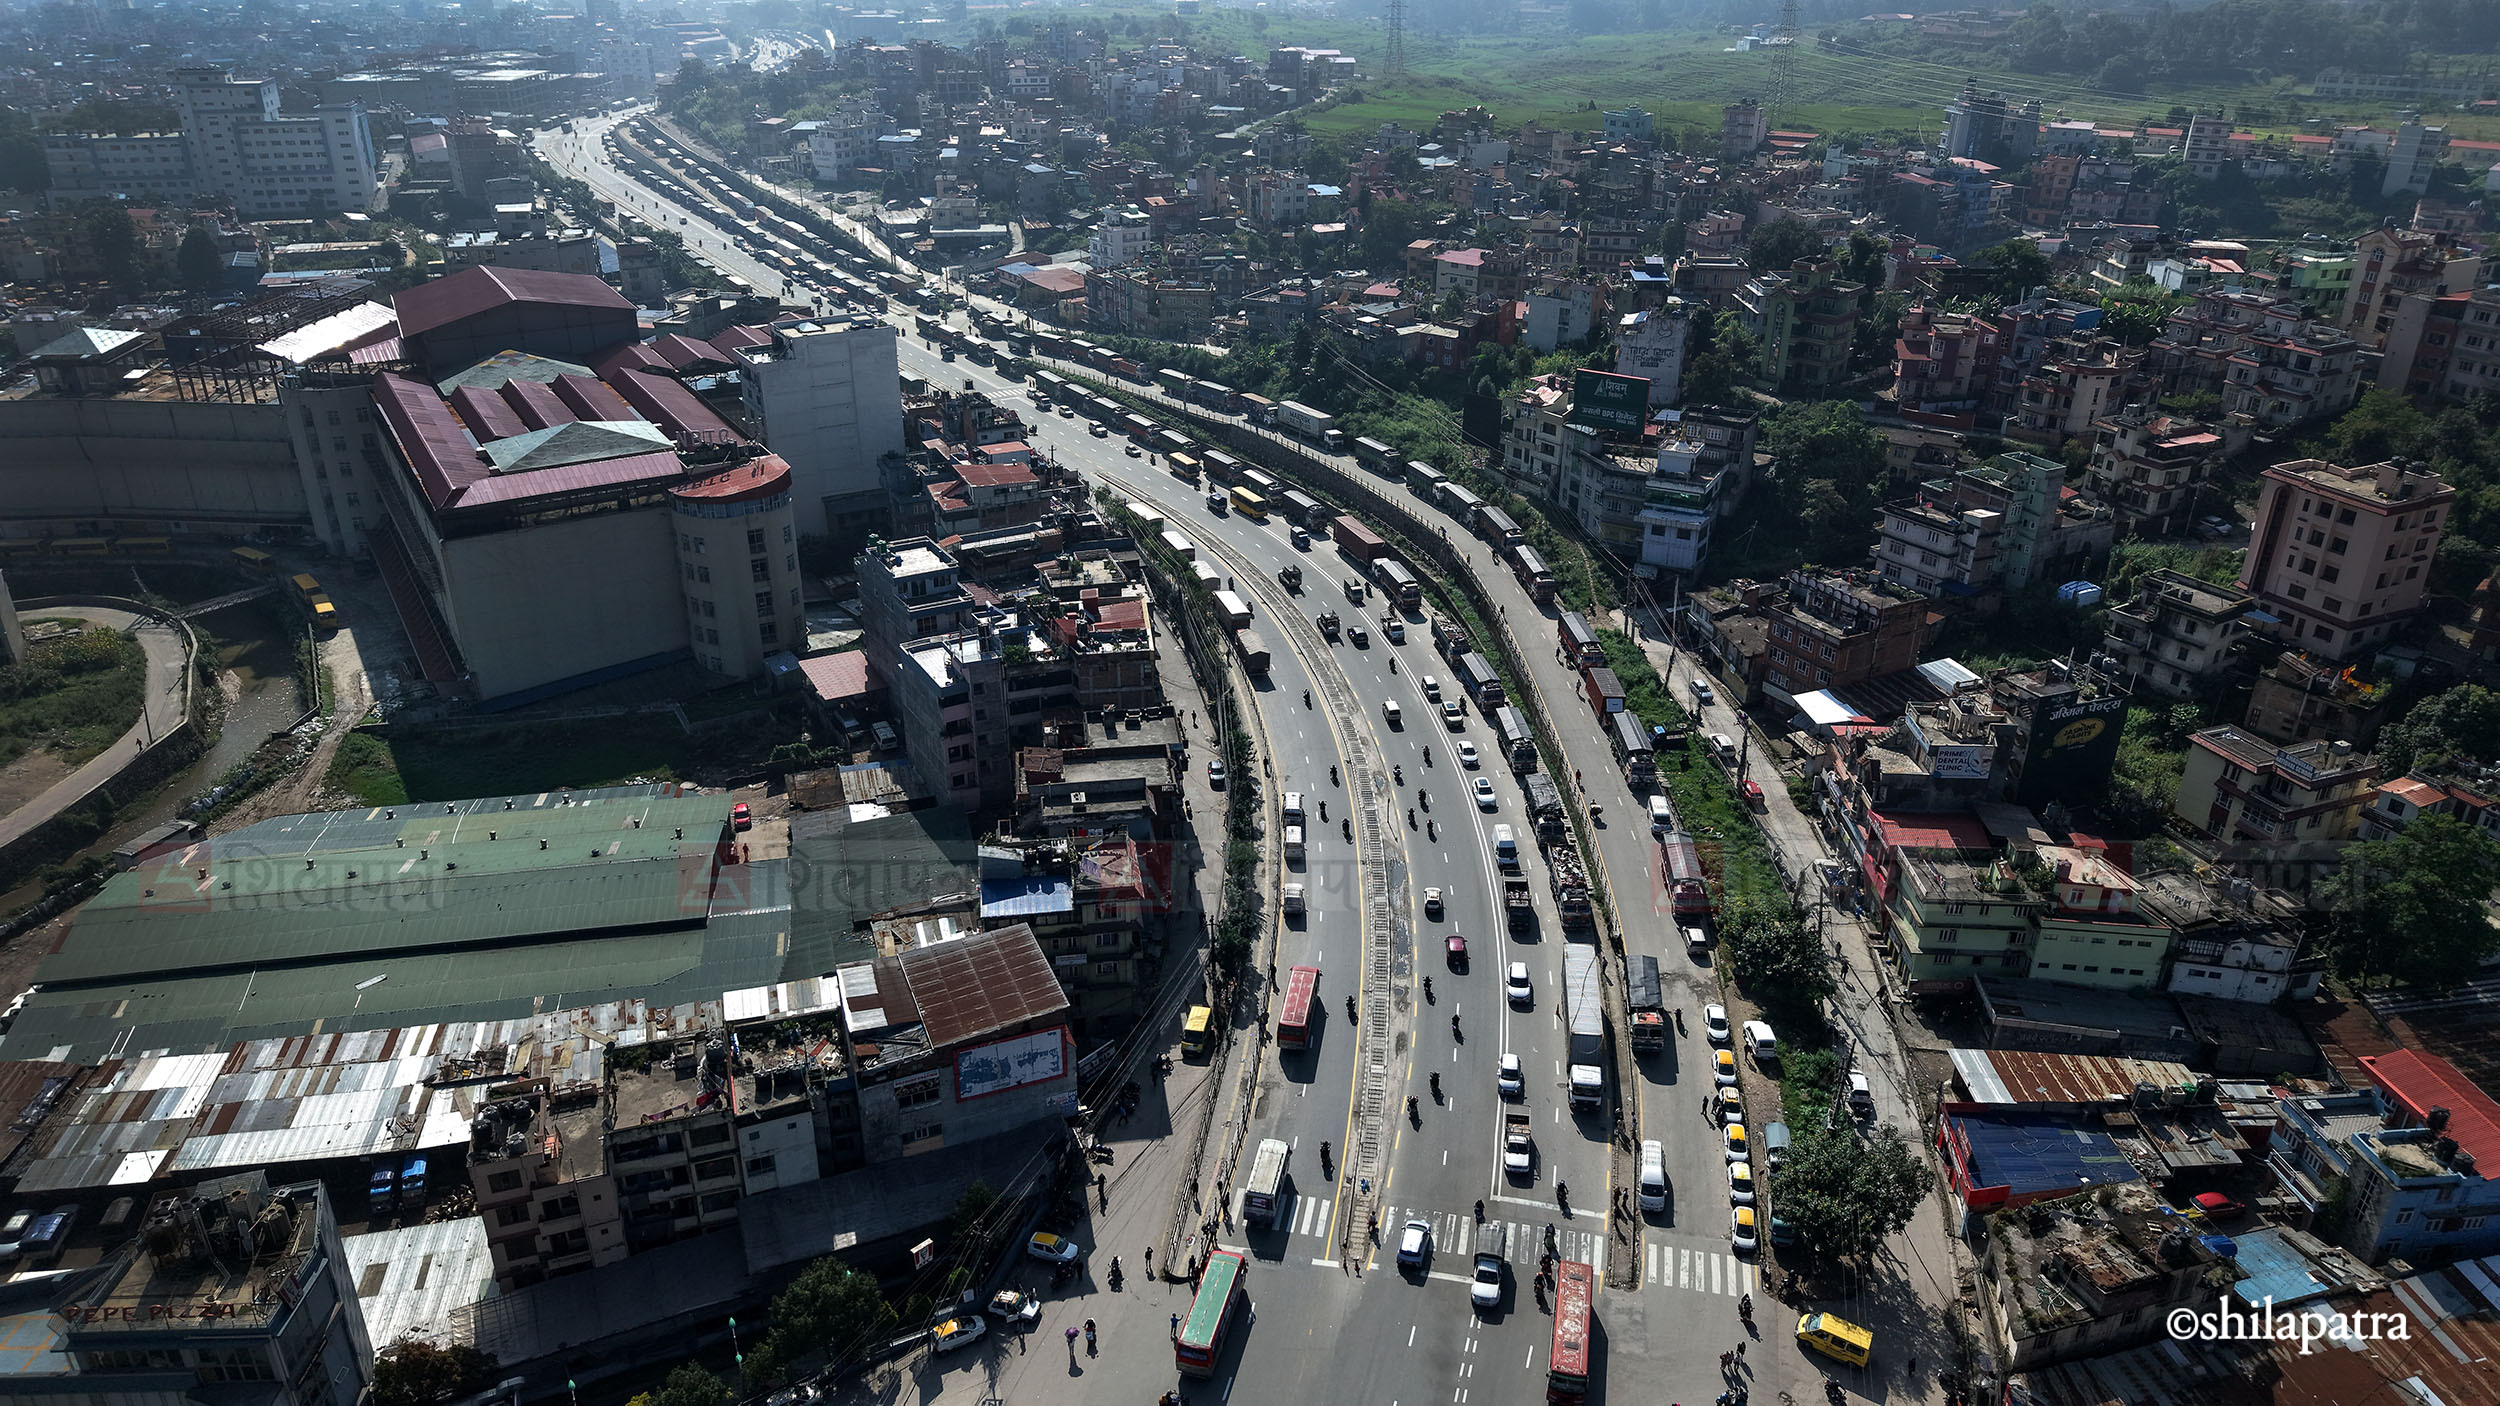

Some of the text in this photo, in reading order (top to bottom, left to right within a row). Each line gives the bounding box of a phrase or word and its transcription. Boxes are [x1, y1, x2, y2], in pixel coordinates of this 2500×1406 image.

[2063, 722, 2097, 736] JASMINE
[1939, 750, 1965, 758] PRIME
[1937, 757, 1968, 765] DENTAL
[63, 1303, 236, 1323] PEPE PIZZA
